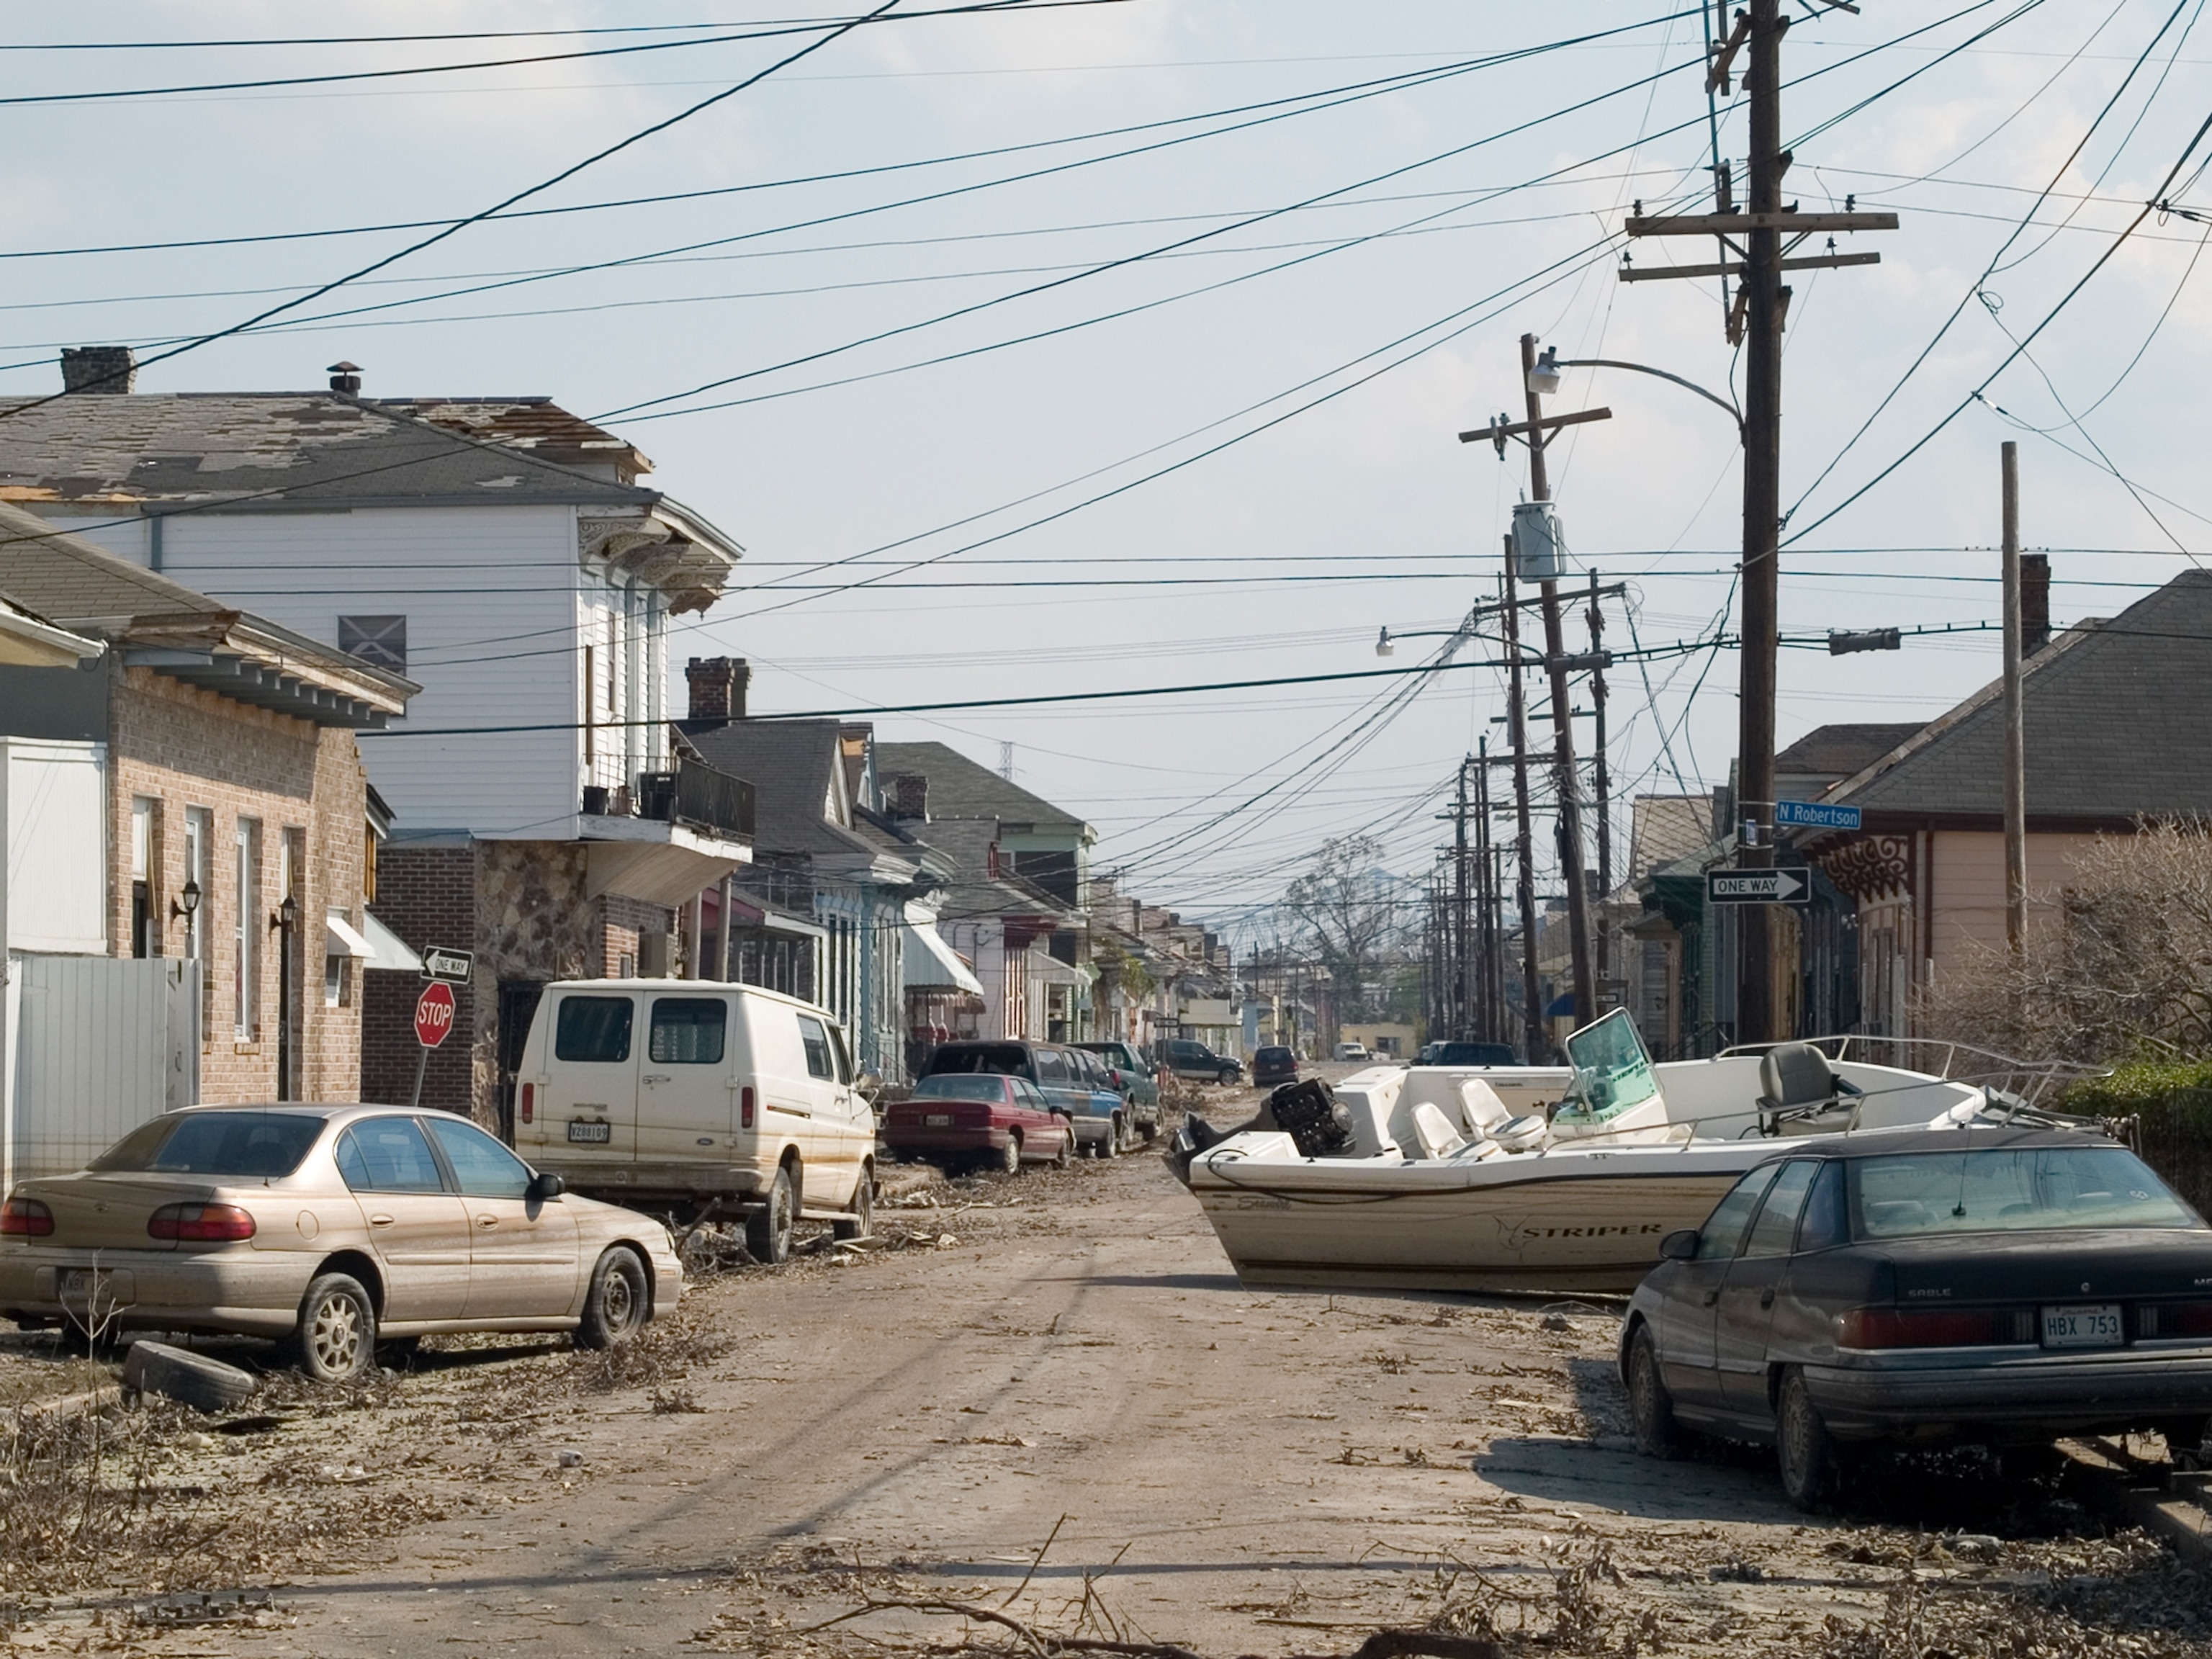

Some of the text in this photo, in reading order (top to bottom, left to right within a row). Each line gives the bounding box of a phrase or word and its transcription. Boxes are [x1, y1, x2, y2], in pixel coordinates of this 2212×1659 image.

[1779, 804, 1858, 826] N Robertson
[1718, 879, 1778, 892] ONE WAY
[435, 958, 467, 973] ONE WAY
[418, 1001, 451, 1027] STOP
[1522, 1223, 1663, 1238] STRIPER
[1908, 1287, 1951, 1297] SABLE
[2047, 1316, 2118, 1336] HBX 753
